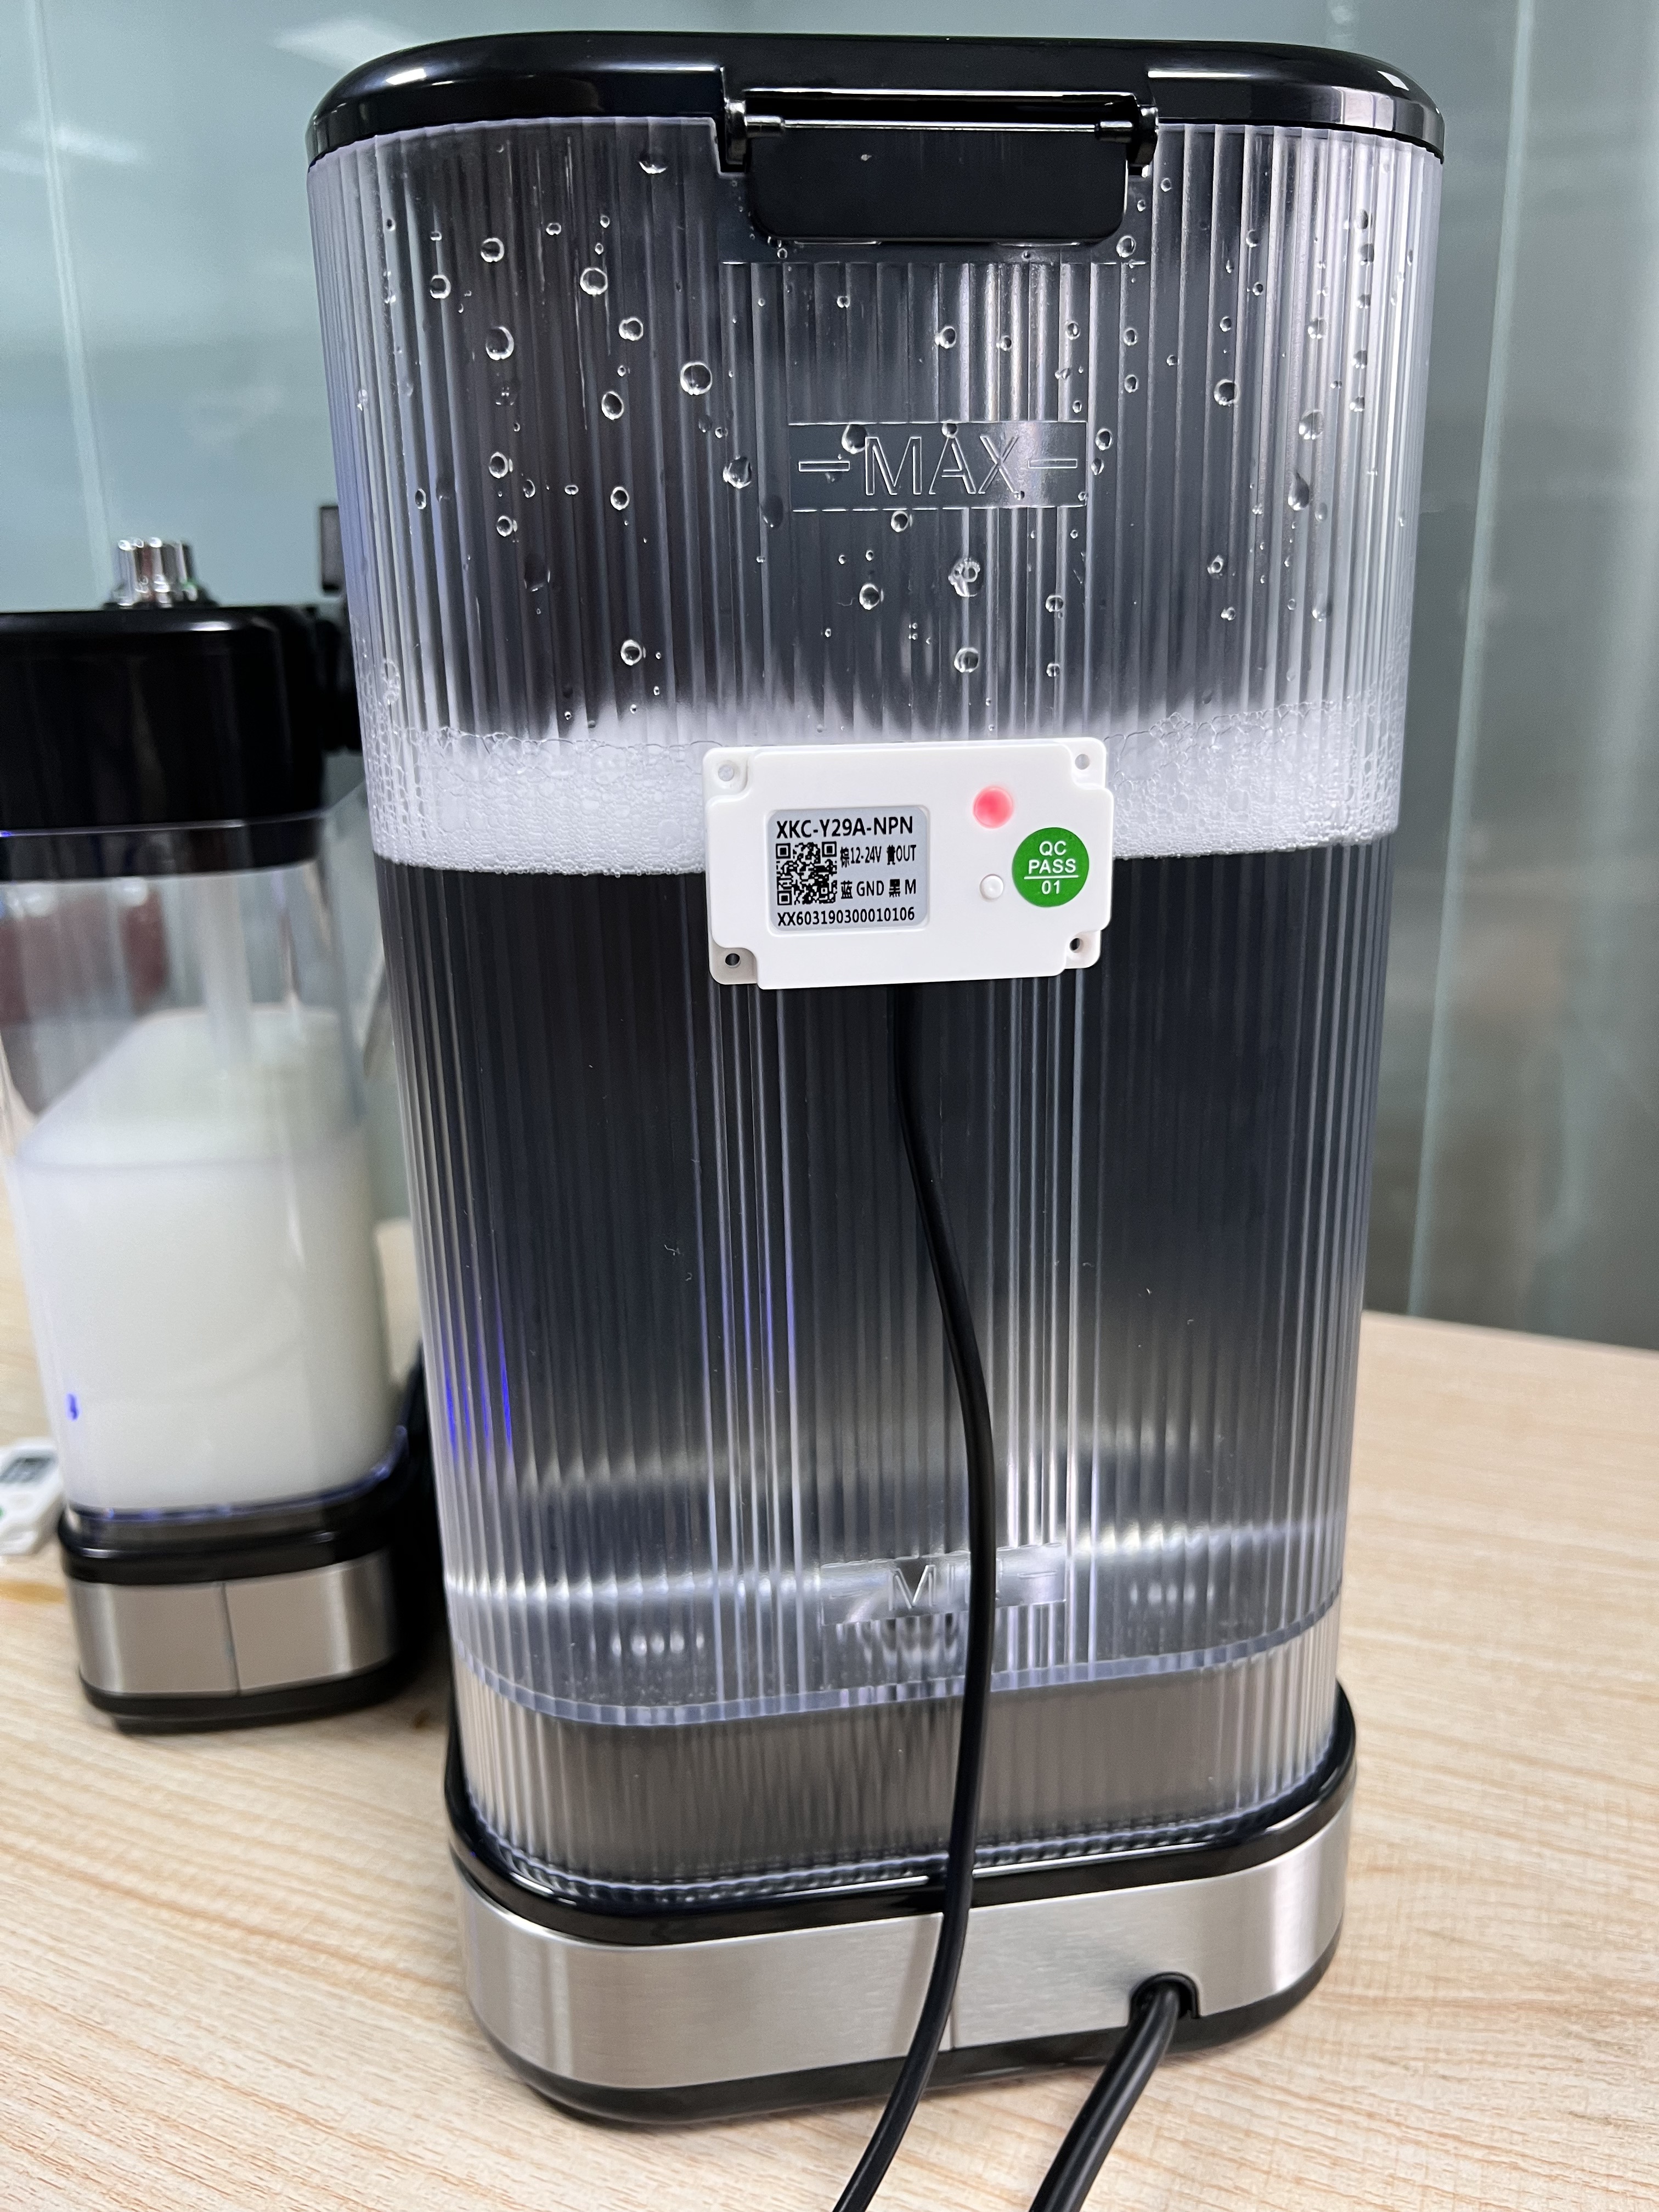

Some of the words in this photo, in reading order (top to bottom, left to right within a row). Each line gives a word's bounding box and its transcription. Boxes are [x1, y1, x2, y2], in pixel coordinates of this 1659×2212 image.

[776, 816, 913, 839] XKC-Y29A-NPN
[1039, 840, 1066, 856] QC
[1028, 858, 1076, 874] PASS
[840, 880, 853, 899] 蓝
[856, 880, 884, 896] GND
[889, 879, 901, 898] 黑
[905, 879, 916, 895] M
[1041, 880, 1060, 895] 01
[777, 906, 915, 926] XX603190300010106
